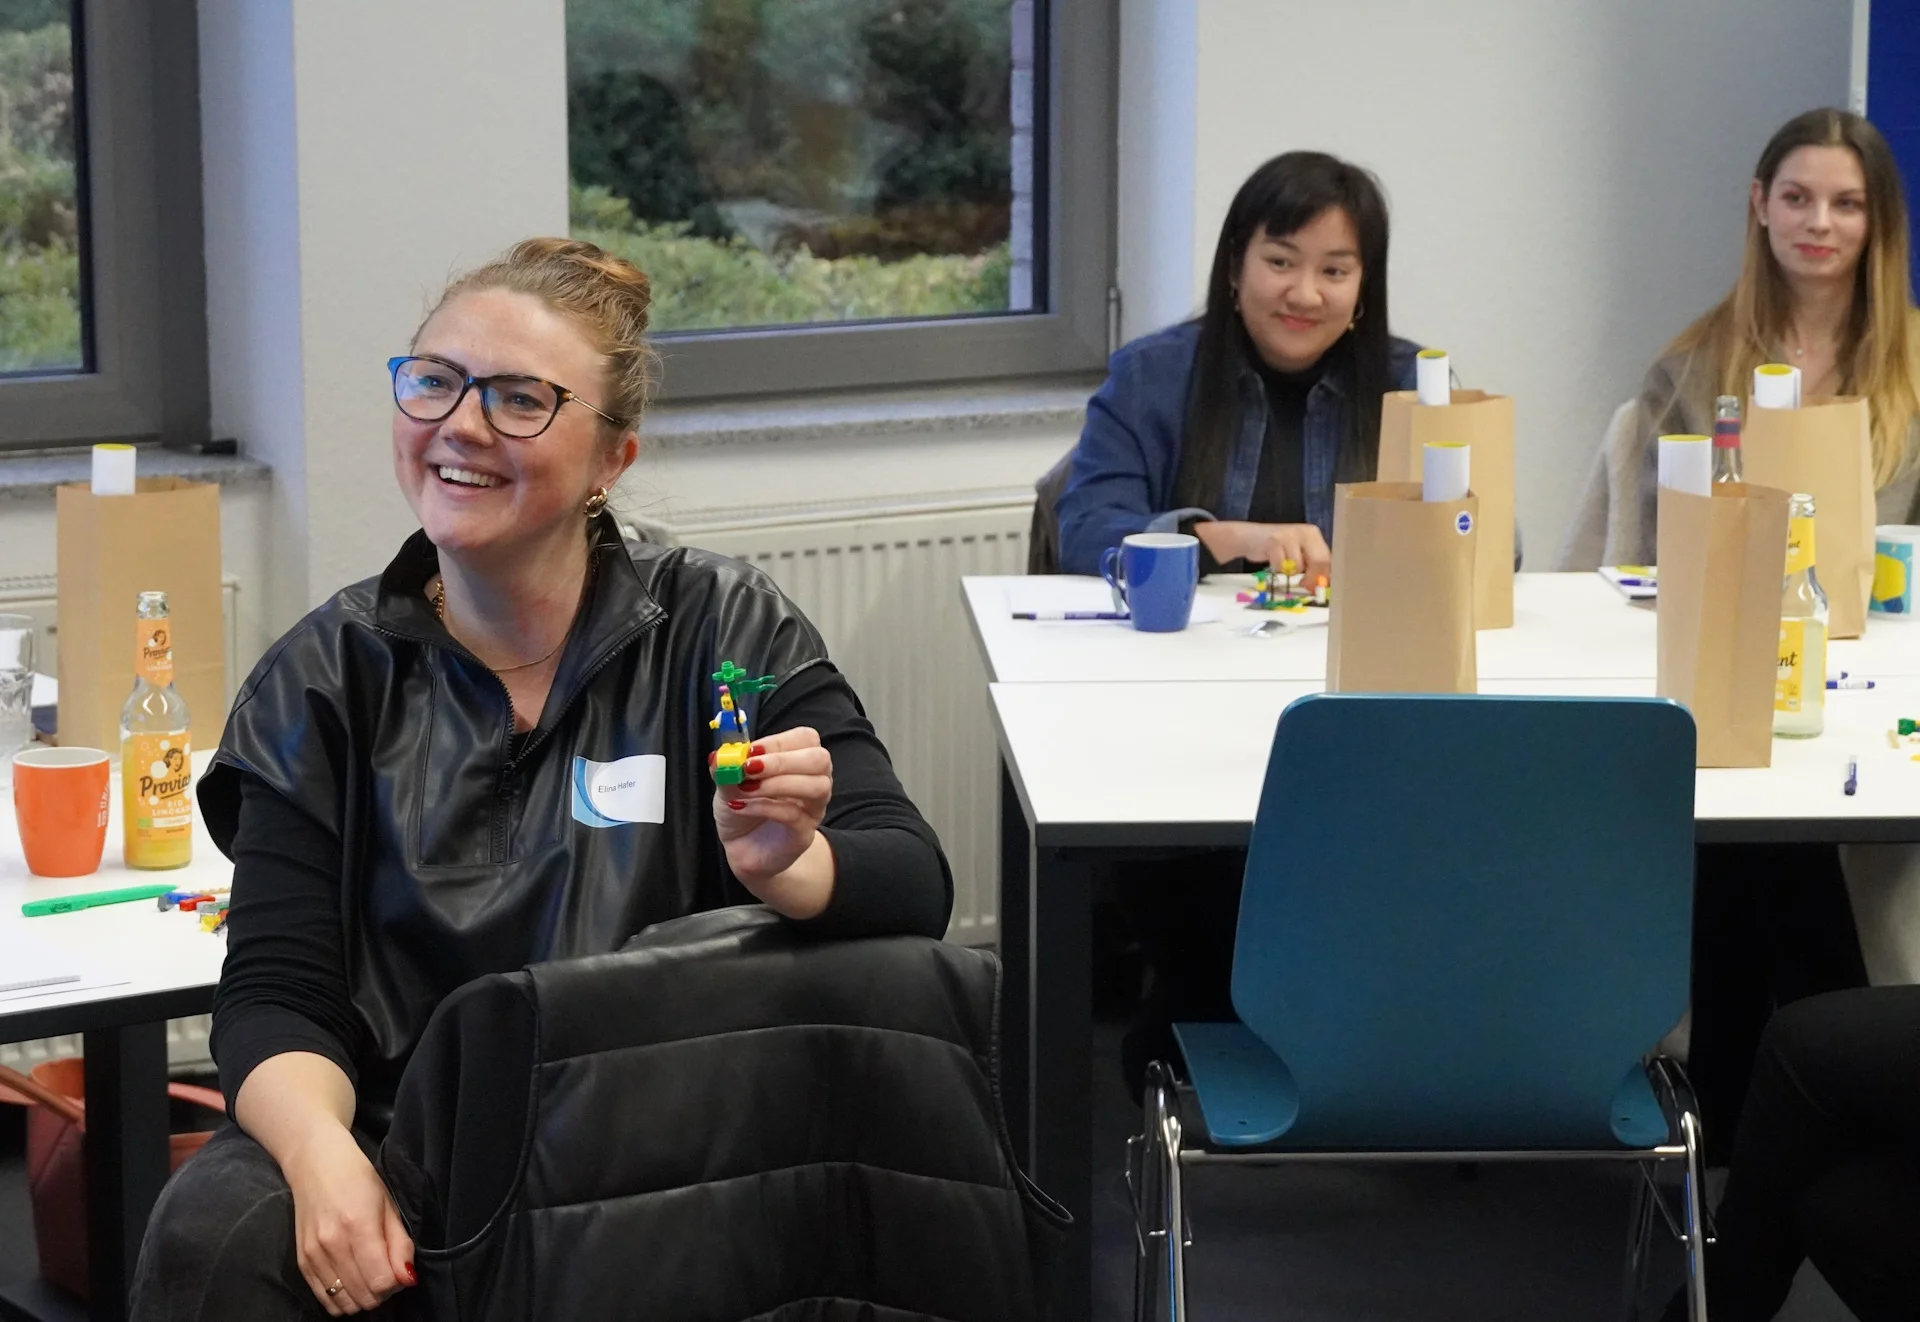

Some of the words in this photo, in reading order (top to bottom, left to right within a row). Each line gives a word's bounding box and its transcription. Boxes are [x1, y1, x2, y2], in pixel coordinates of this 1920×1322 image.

[1777, 651, 1798, 667] nt
[139, 773, 191, 797] Provia
[598, 785, 617, 793] Elina
[618, 780, 636, 789] Hafer
